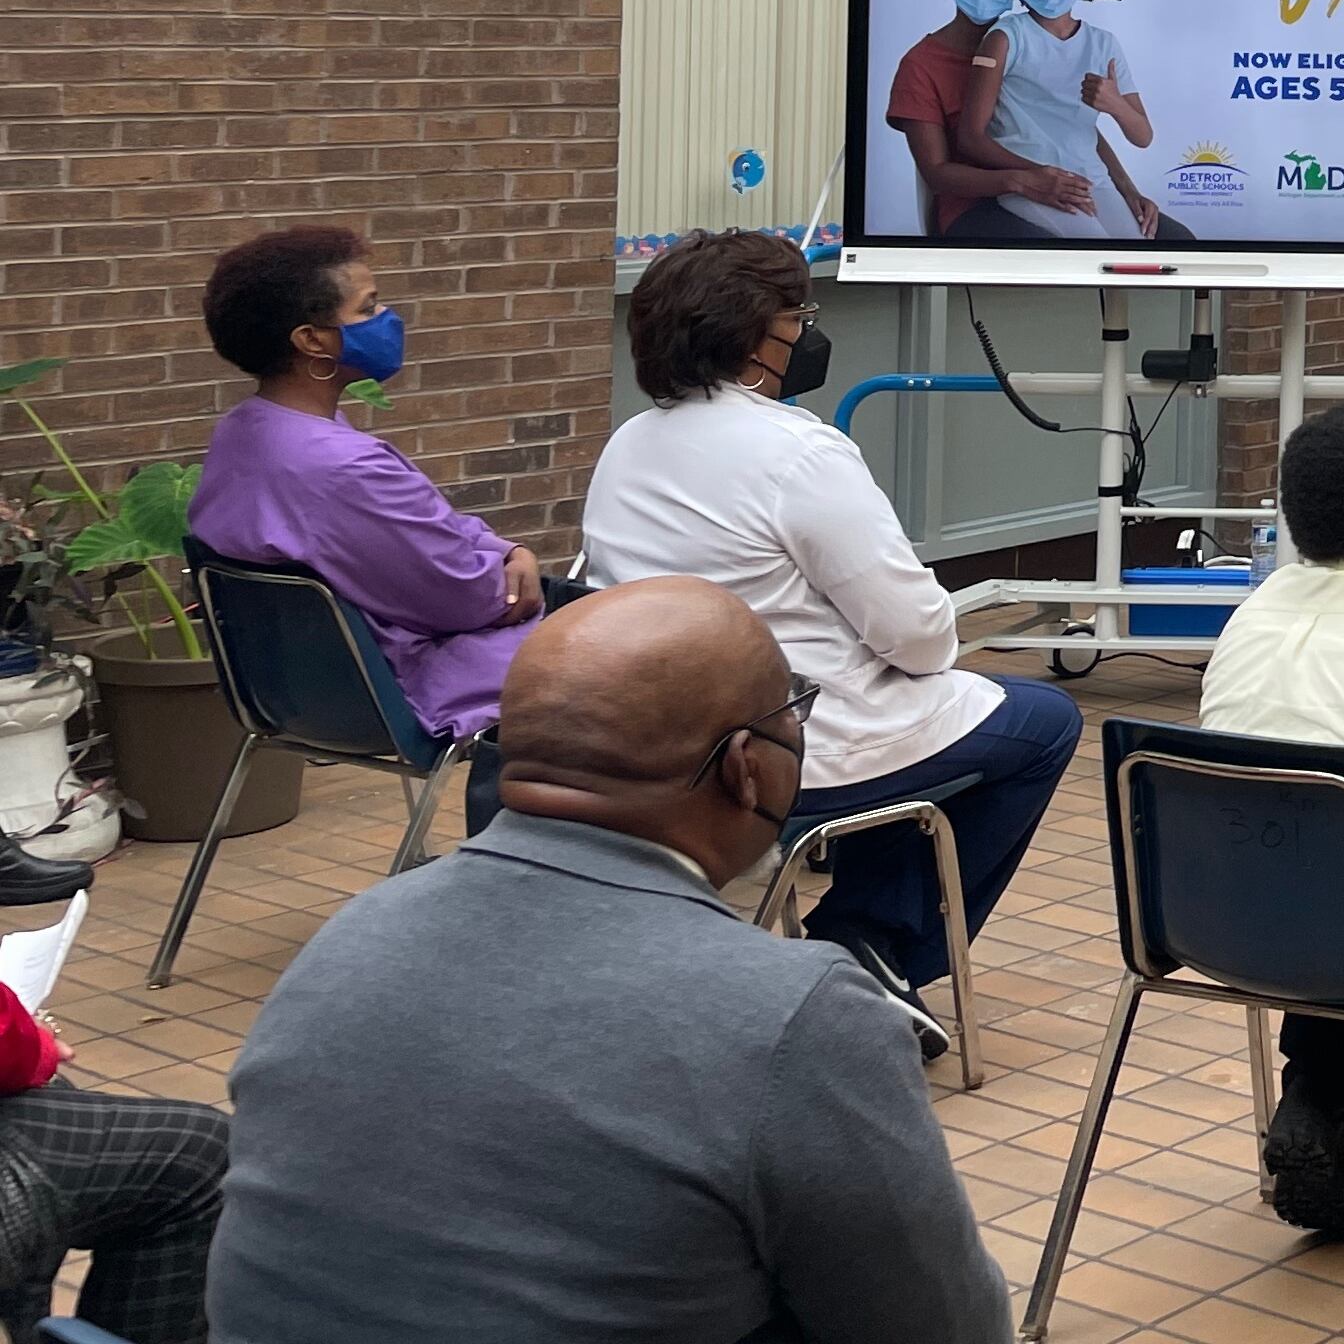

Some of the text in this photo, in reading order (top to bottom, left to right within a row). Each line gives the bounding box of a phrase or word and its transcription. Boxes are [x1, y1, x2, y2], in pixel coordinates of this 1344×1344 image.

[1233, 52, 1292, 69] NOW
[1230, 76, 1321, 101] AGES
[1180, 172, 1234, 183] DETROIT
[1167, 182, 1244, 191] PUBLIC SCHOOLS
